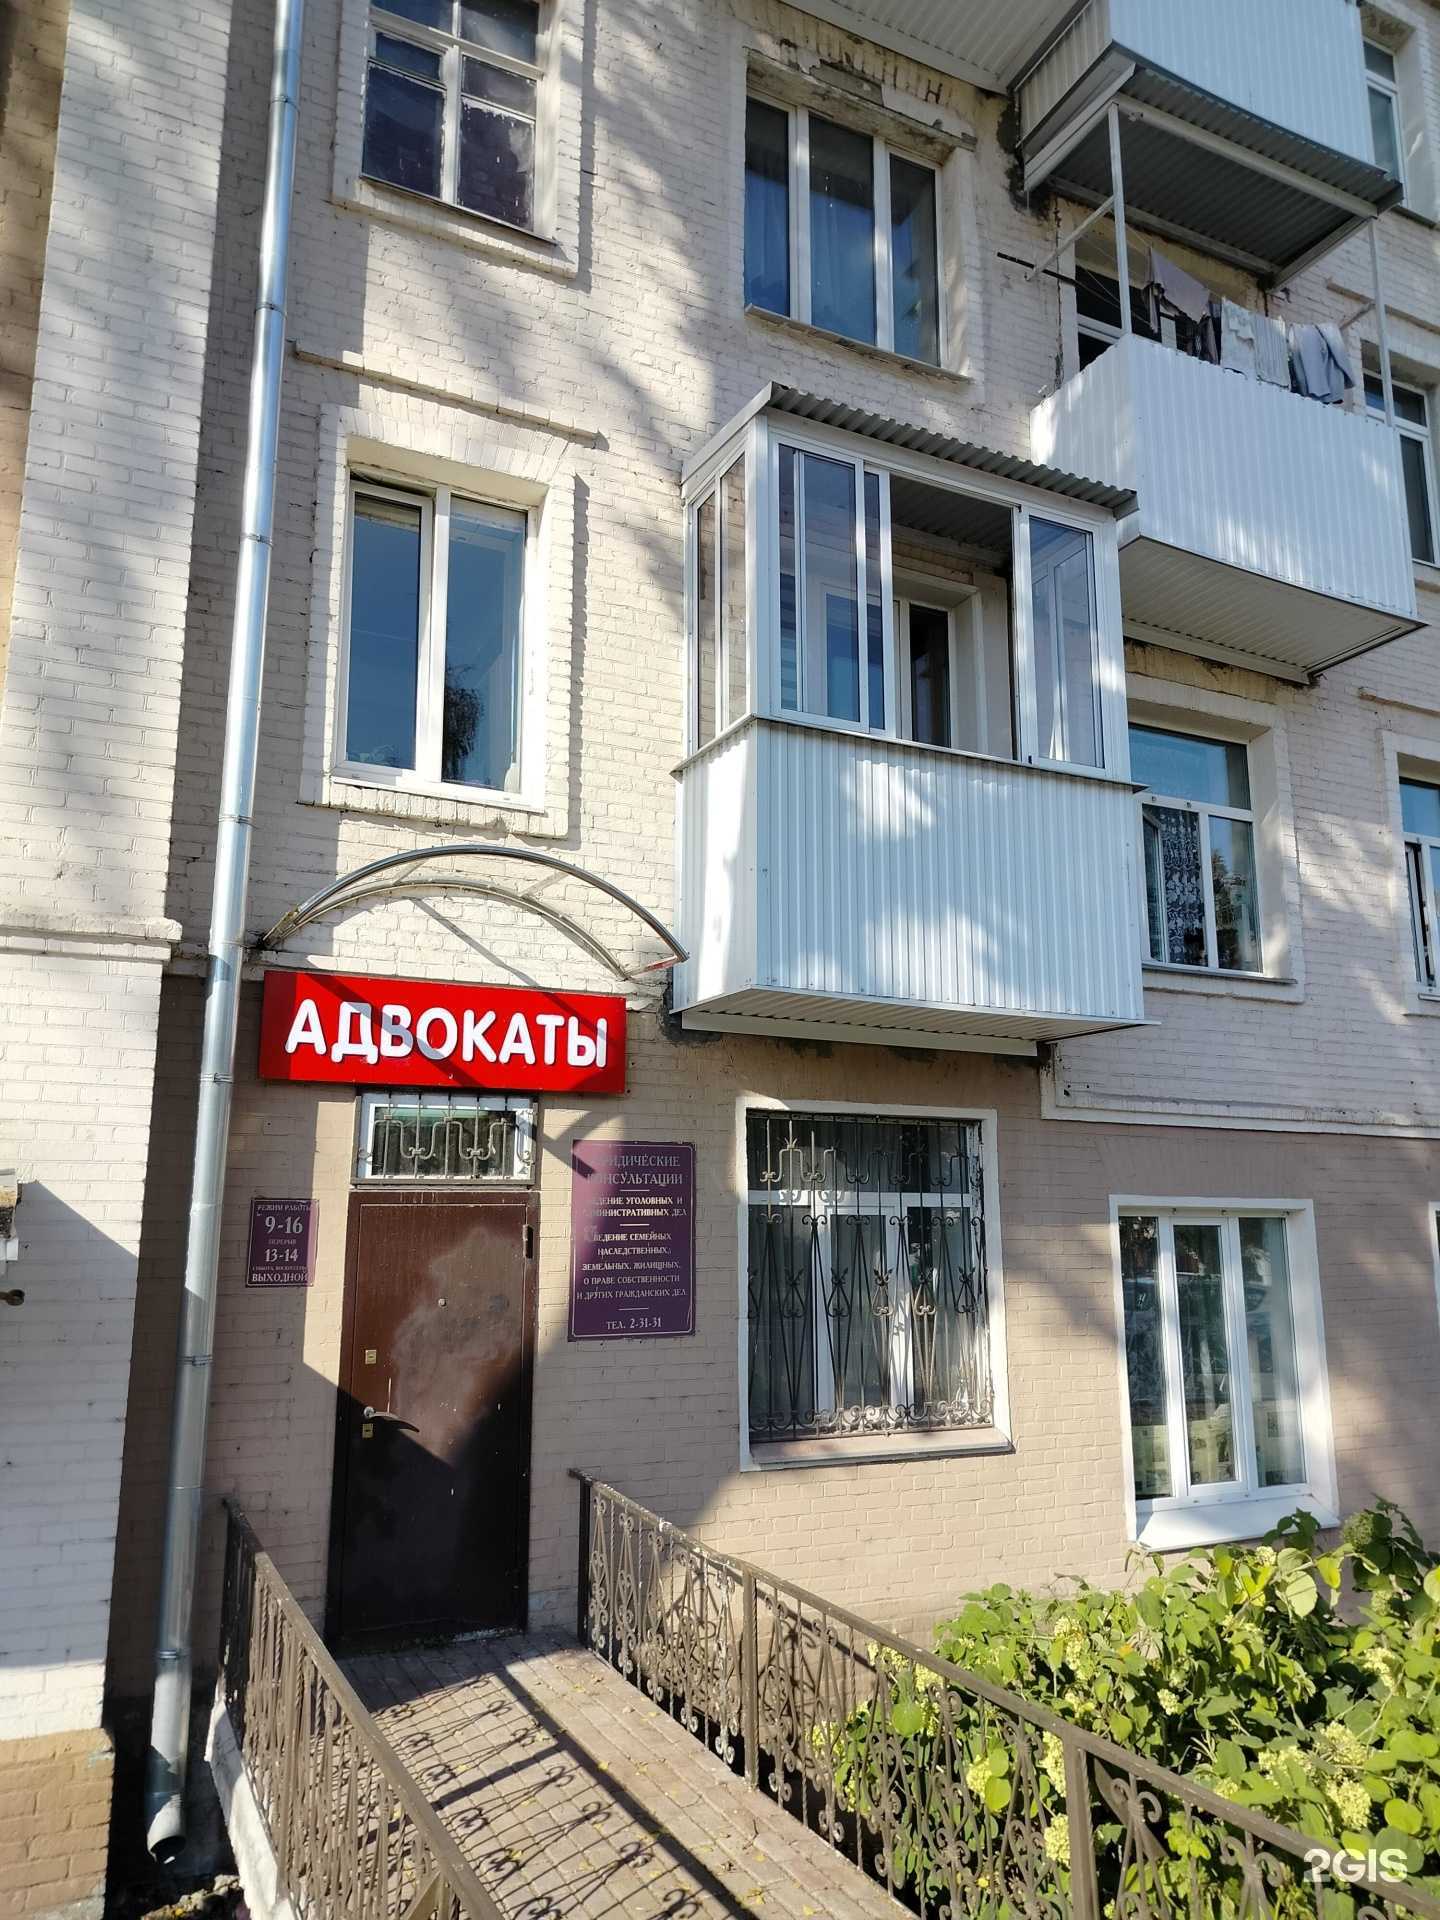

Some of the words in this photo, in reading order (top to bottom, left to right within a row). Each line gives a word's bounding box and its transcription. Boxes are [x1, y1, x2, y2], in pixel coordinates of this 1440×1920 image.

[285, 998, 607, 1069] АДВОКАТЫ
[590, 1154, 681, 1169] ИДИЧЕСКИЕ
[587, 1173, 683, 1186] НСУЛЬТАЦИИ
[625, 1196, 673, 1206] УГОЛОВНЫХ
[676, 1197, 683, 1205] И
[671, 1208, 688, 1218] ДЕЛ
[265, 1216, 303, 1234] 9-16
[629, 1231, 672, 1241] СЕМЕЙНЫХ
[265, 1248, 298, 1262] 13-14
[252, 1271, 310, 1283] ВЫХОДНОЙ
[583, 1277, 590, 1286] О
[591, 1276, 616, 1286] ПРАВЕ
[617, 1275, 681, 1285] СОБСТВЕННОСТИ
[576, 1291, 583, 1300] И
[583, 1290, 614, 1301] ДРУГИХ
[615, 1289, 671, 1299] ГРАЖДАНСКИХ
[671, 1288, 687, 1298] ДЕЛ
[606, 1320, 626, 1330] ТЕЛ.
[629, 1317, 662, 1329] 2-31-31
